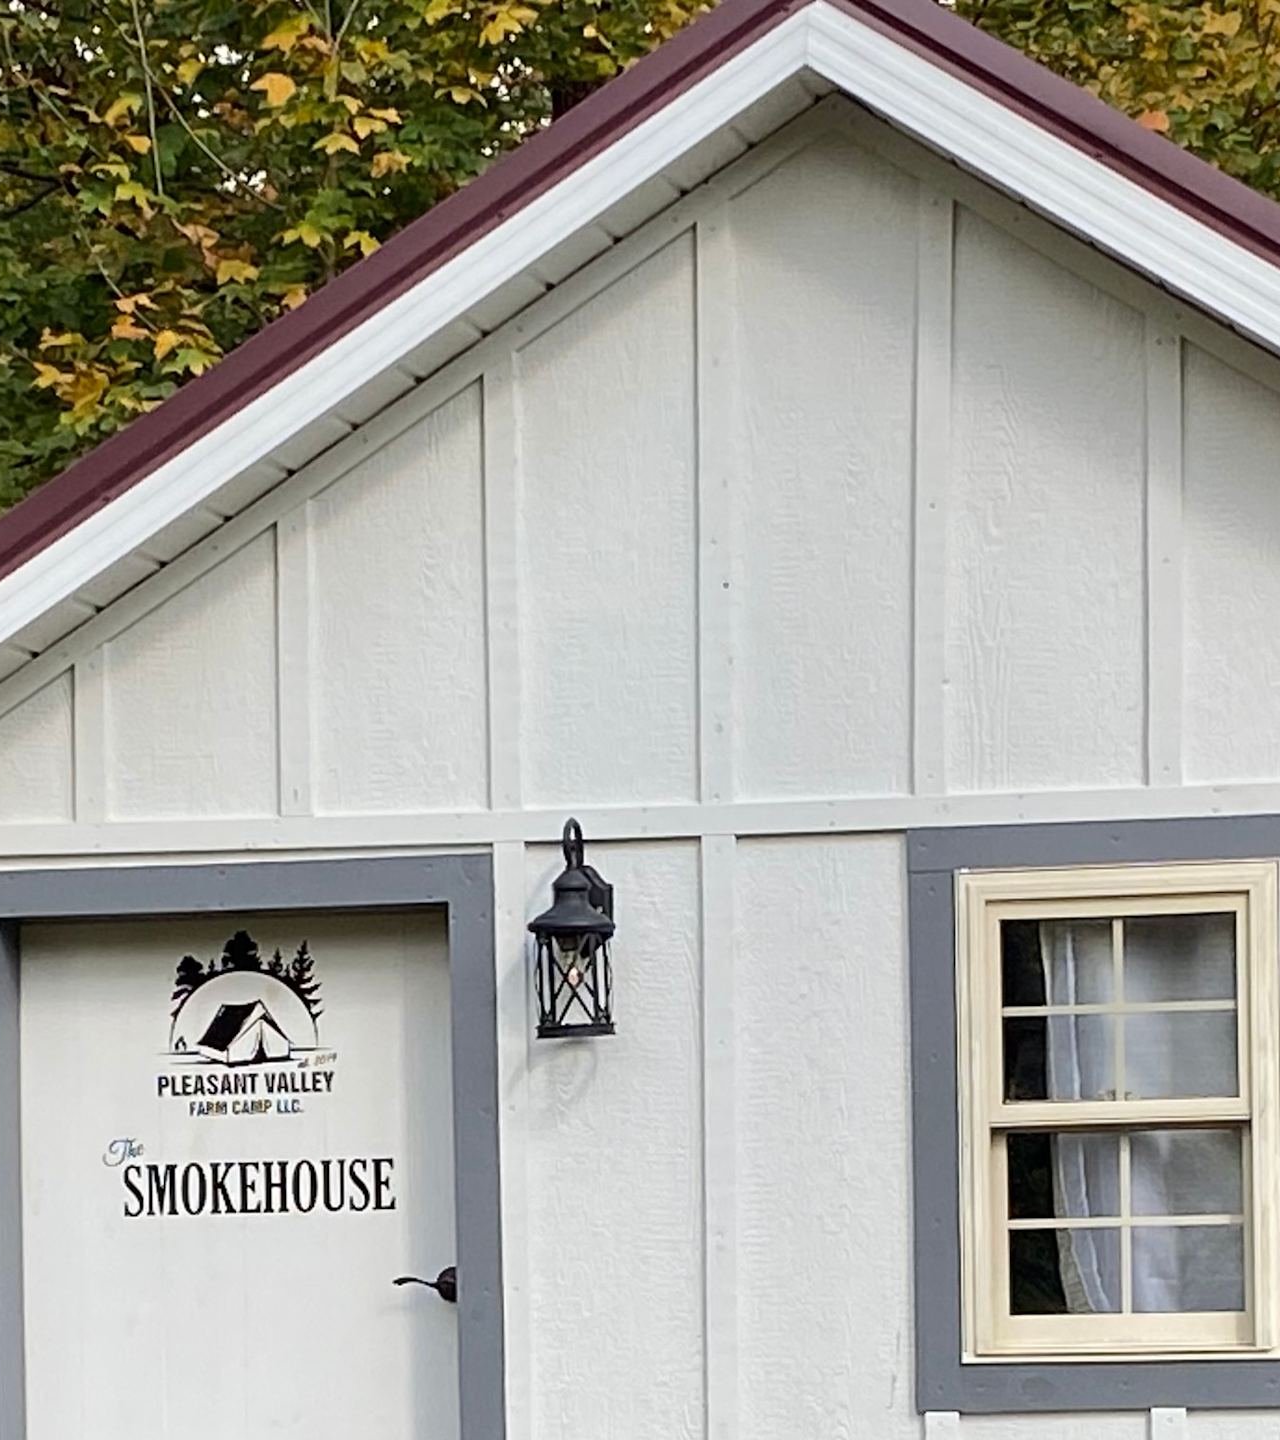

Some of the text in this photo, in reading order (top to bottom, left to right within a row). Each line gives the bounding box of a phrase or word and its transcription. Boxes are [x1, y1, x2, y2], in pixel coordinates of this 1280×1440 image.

[157, 1071, 335, 1097] PLEASANT VALLEY
[189, 1101, 228, 1116] FARM
[231, 1099, 272, 1115] CAMP
[103, 1137, 144, 1167] The
[123, 1157, 397, 1217] SMOKEHOUSE
